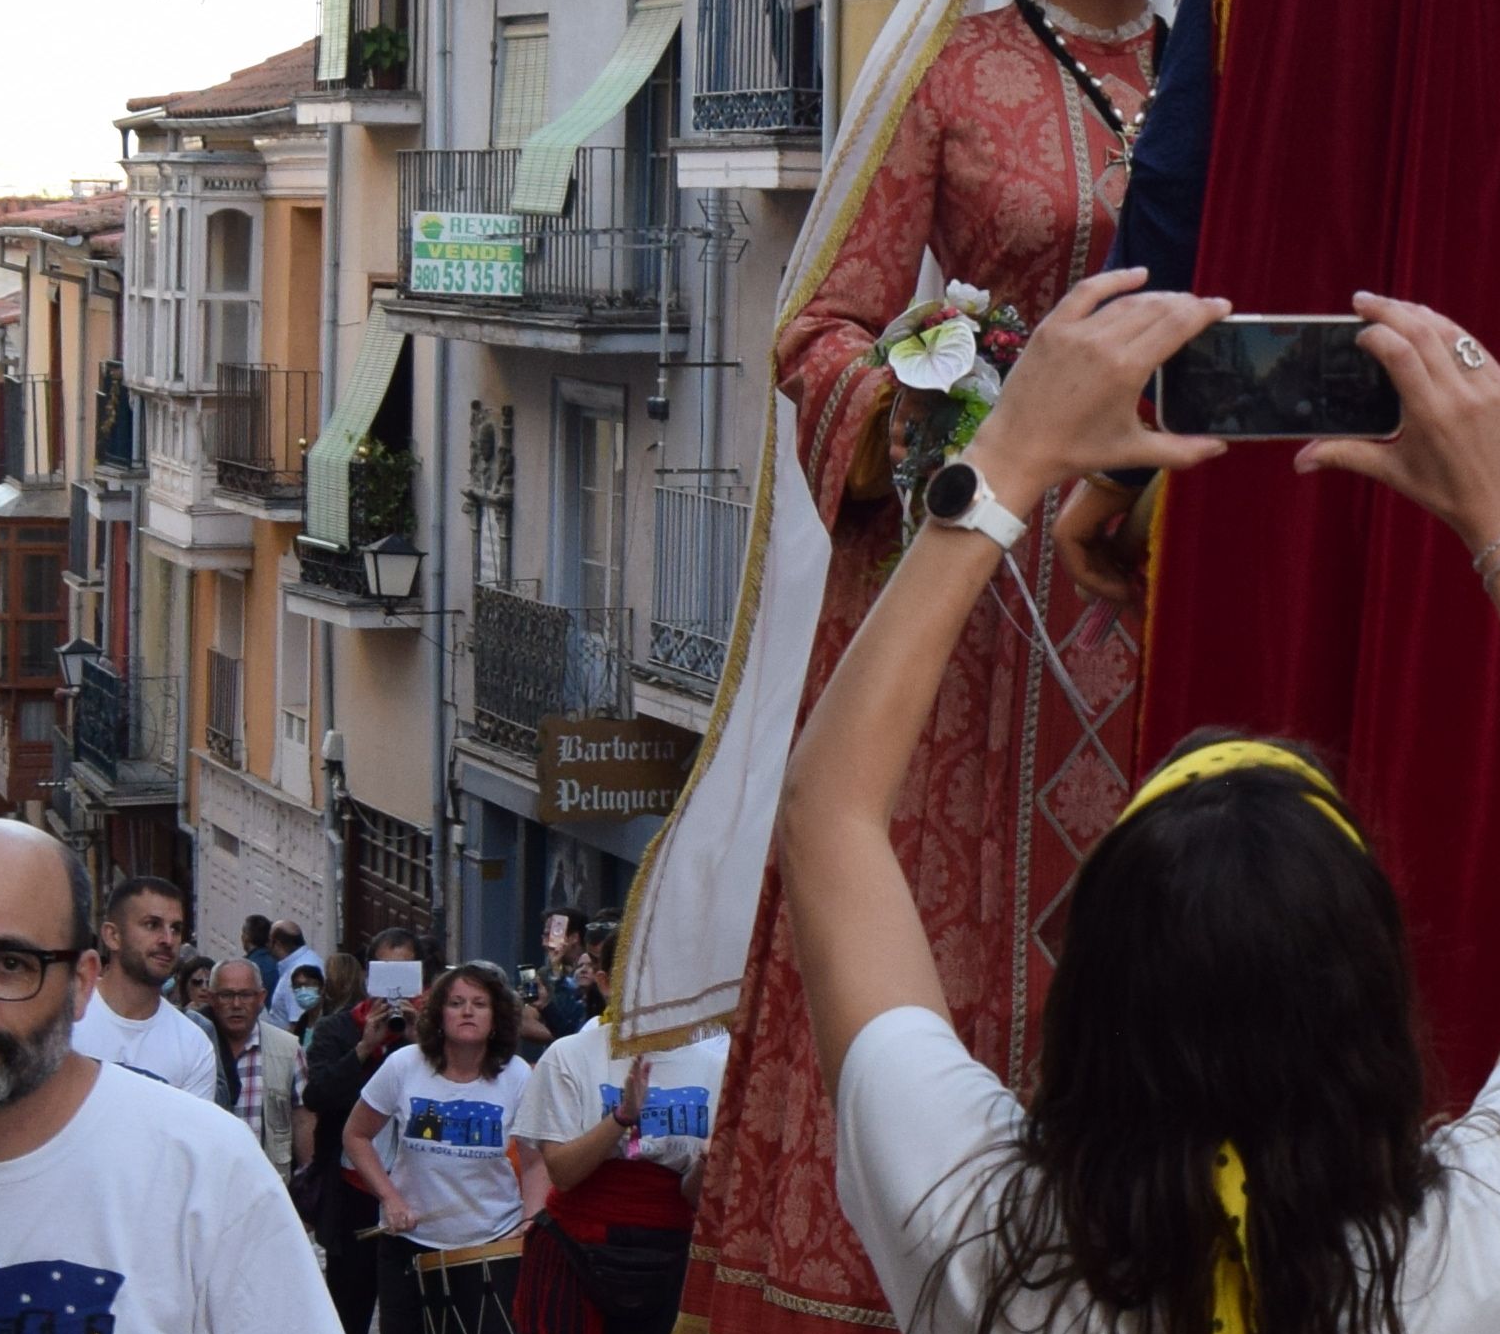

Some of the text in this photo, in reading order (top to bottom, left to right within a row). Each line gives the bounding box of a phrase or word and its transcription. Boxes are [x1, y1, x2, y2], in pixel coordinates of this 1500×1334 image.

[428, 243, 512, 261] VENDE
[414, 260, 522, 294] 980 53 35 36
